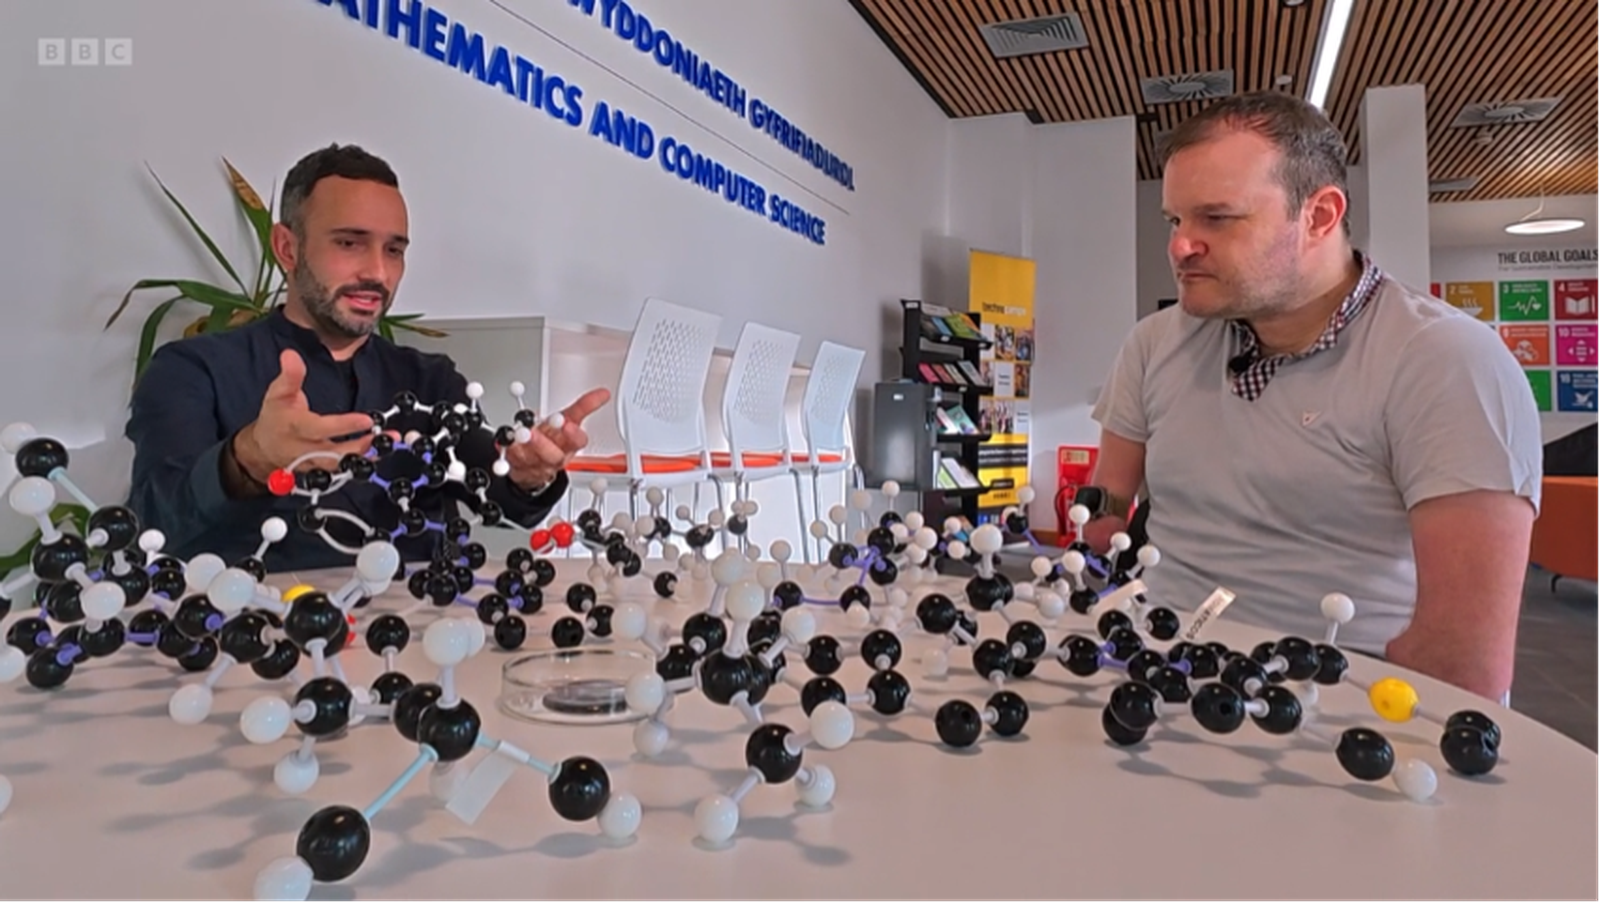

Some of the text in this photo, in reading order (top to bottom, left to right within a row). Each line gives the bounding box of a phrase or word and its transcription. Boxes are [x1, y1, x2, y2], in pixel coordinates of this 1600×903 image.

[317, 0, 826, 245] THEMATICS AND COMPUTER SCIENCE
[1498, 248, 1599, 265] THE GLOBAL GOALS
